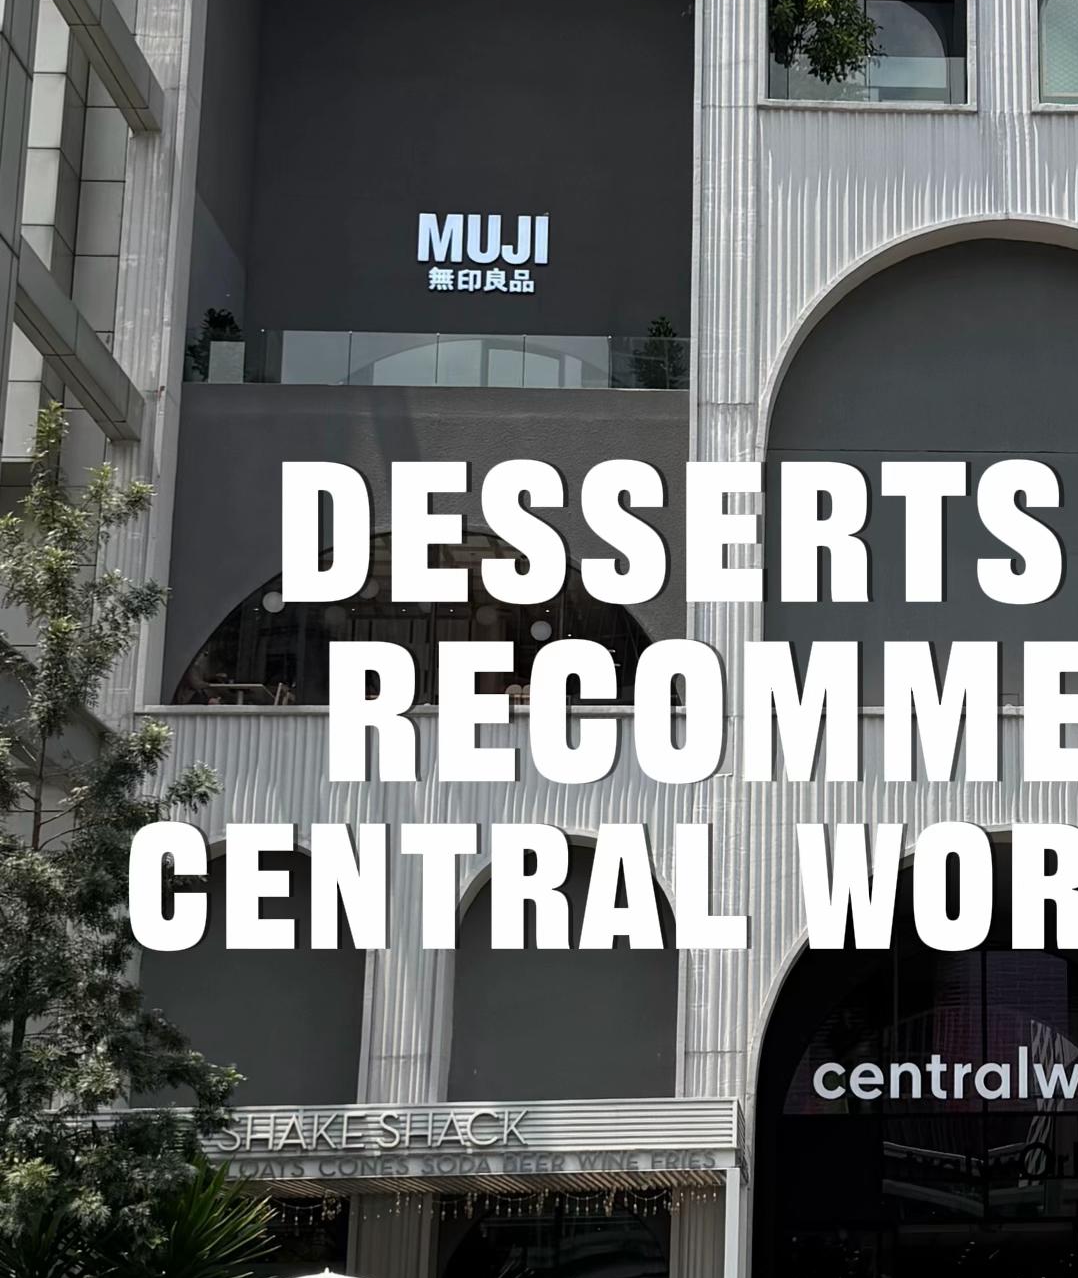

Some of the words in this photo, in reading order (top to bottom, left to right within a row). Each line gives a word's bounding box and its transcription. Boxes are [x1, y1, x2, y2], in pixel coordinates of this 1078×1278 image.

[417, 212, 549, 264] MUJI
[428, 267, 535, 293] 無印良品
[217, 1112, 366, 1151] SHAKE
[376, 1108, 529, 1148] SHACK
[225, 1158, 305, 1179] LOATS
[318, 1156, 409, 1177] CONES
[420, 1154, 492, 1175] SODA
[502, 1152, 566, 1173] BEER
[576, 1151, 639, 1171] WINE
[650, 1150, 717, 1170] FRIES
